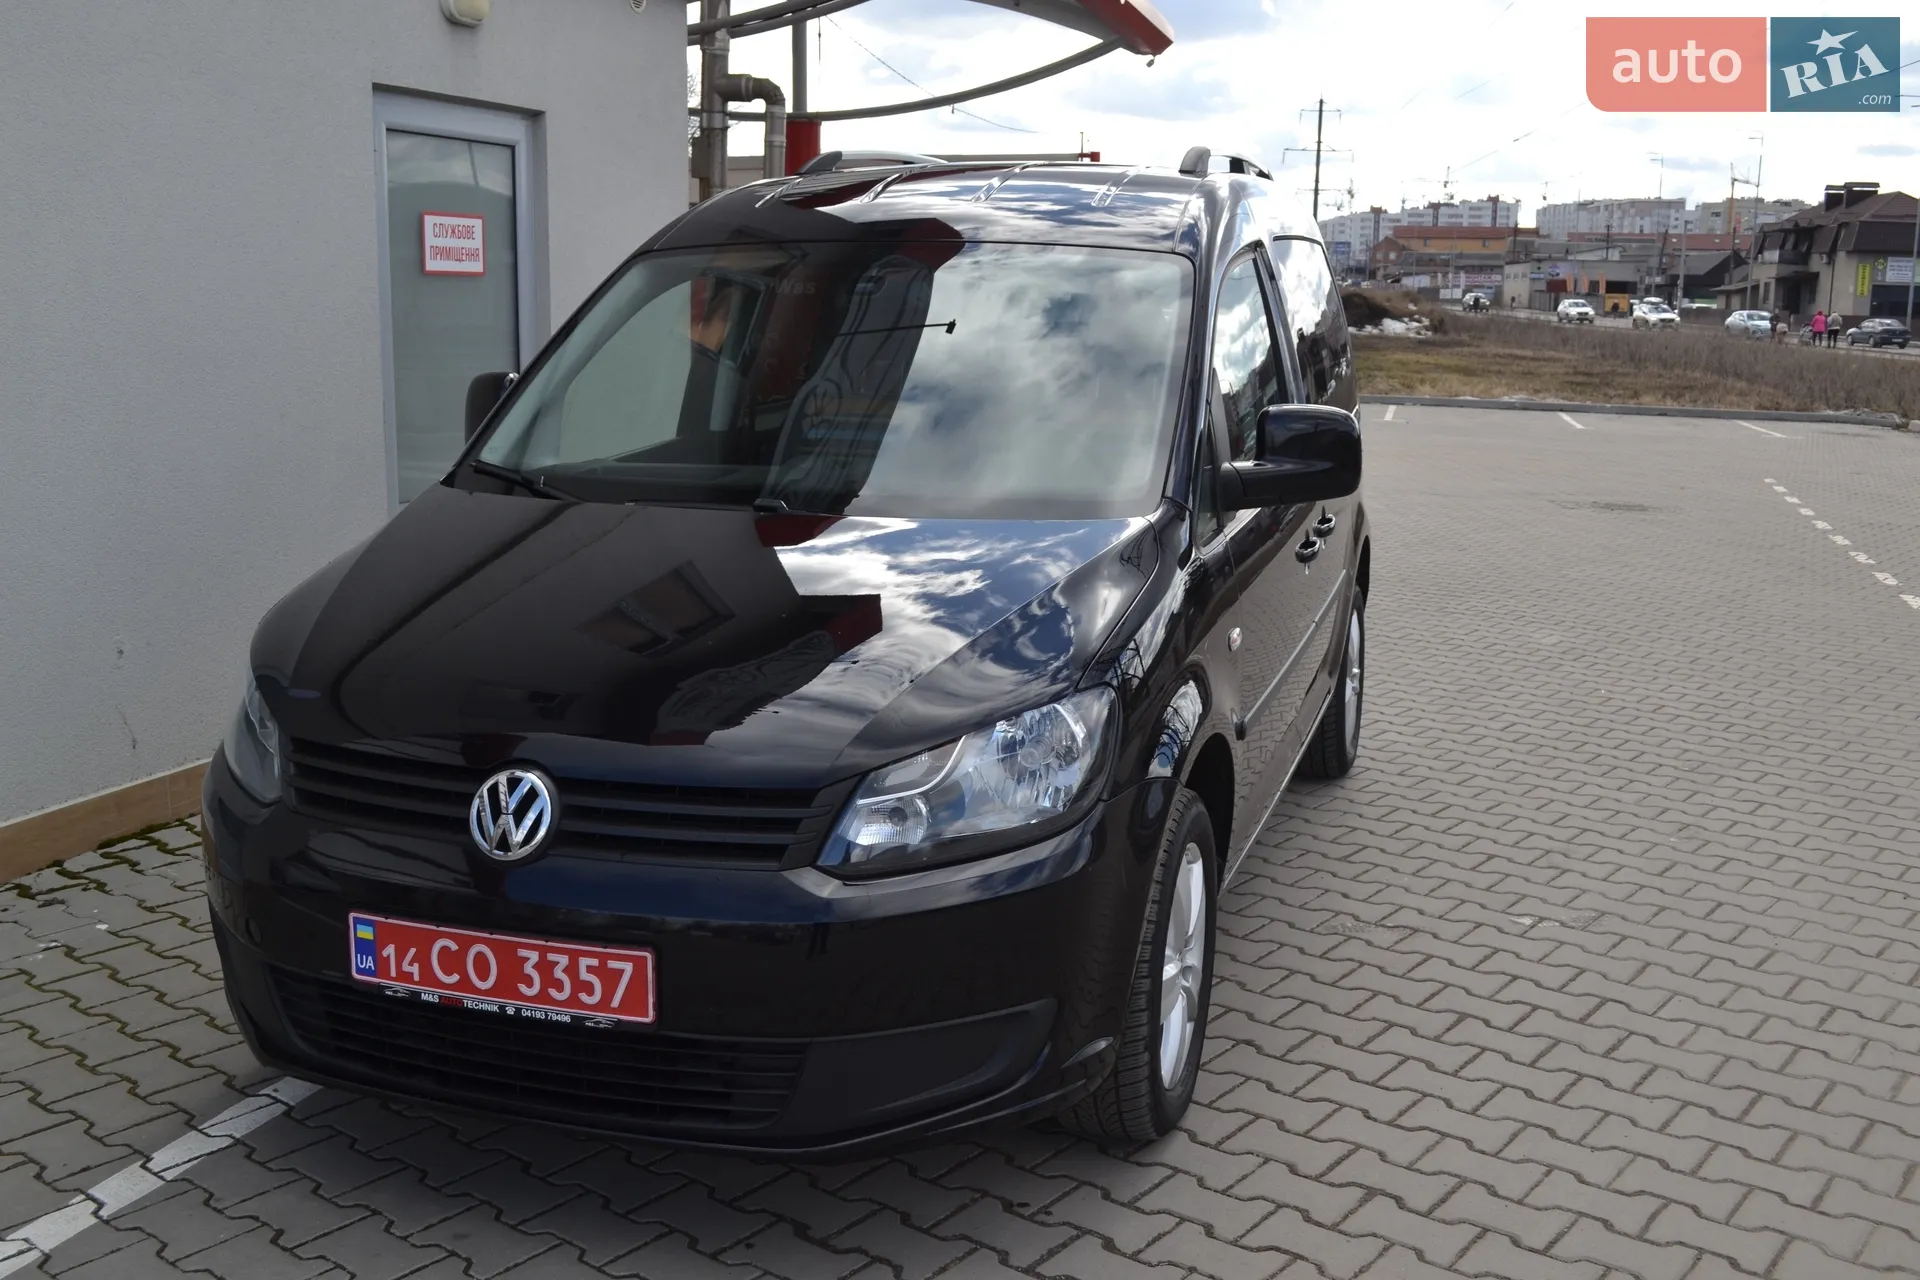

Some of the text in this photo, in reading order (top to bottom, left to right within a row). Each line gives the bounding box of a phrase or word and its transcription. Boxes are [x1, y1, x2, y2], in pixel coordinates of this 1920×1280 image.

[432, 222, 476, 240] СЛУЖБОВЕ
[429, 245, 480, 263] ПРИМІЩЕННЯ
[357, 953, 375, 971] UA
[516, 948, 634, 1008] 3357
[421, 992, 440, 1003] M&S
[521, 1008, 546, 1019] 04193
[547, 1012, 571, 1023] 79496
